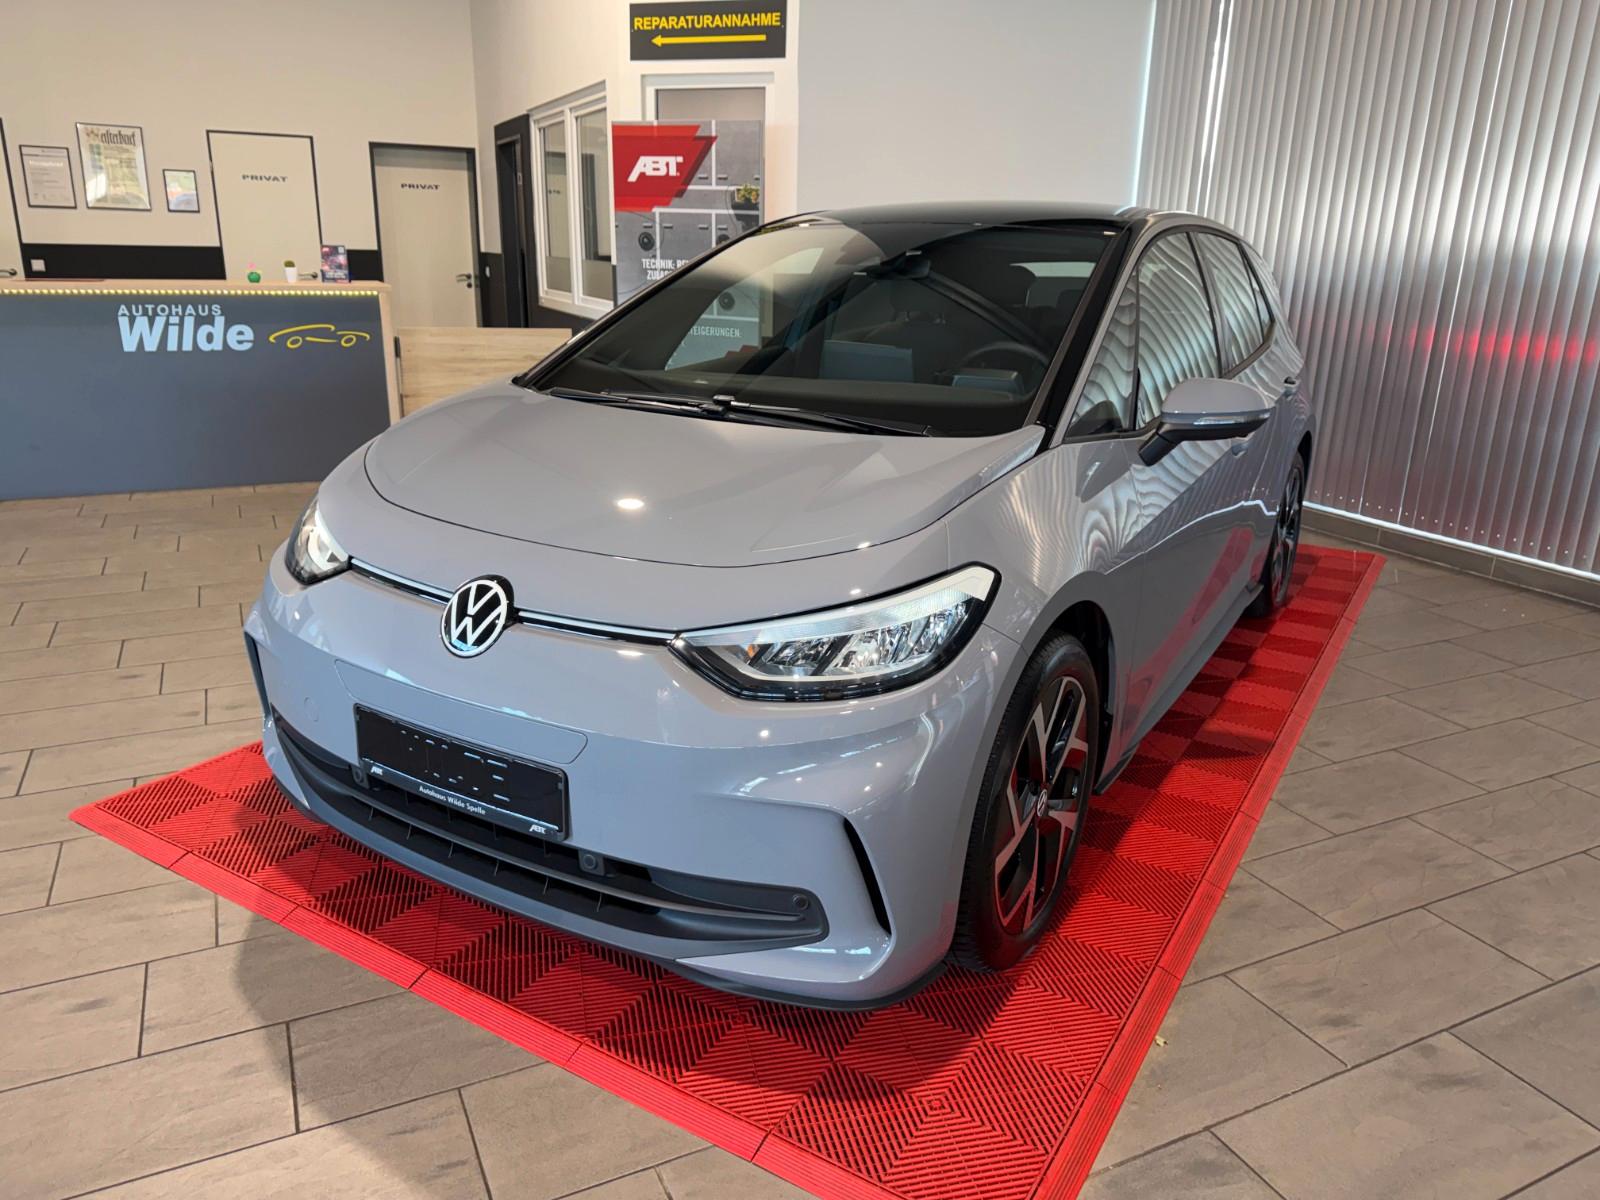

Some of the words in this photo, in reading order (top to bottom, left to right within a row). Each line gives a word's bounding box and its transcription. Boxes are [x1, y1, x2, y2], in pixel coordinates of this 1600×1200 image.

[634, 12, 781, 30] REPARATURANNAHME
[627, 156, 683, 182] ABT
[241, 174, 288, 183] PRIVAT
[400, 183, 440, 191] PRIVAT
[118, 304, 222, 316] AUTOHAUS
[118, 316, 254, 352] Wilde
[419, 785, 446, 800] Autohaus
[447, 796, 465, 808] Wilde
[466, 803, 486, 815] Spelle
